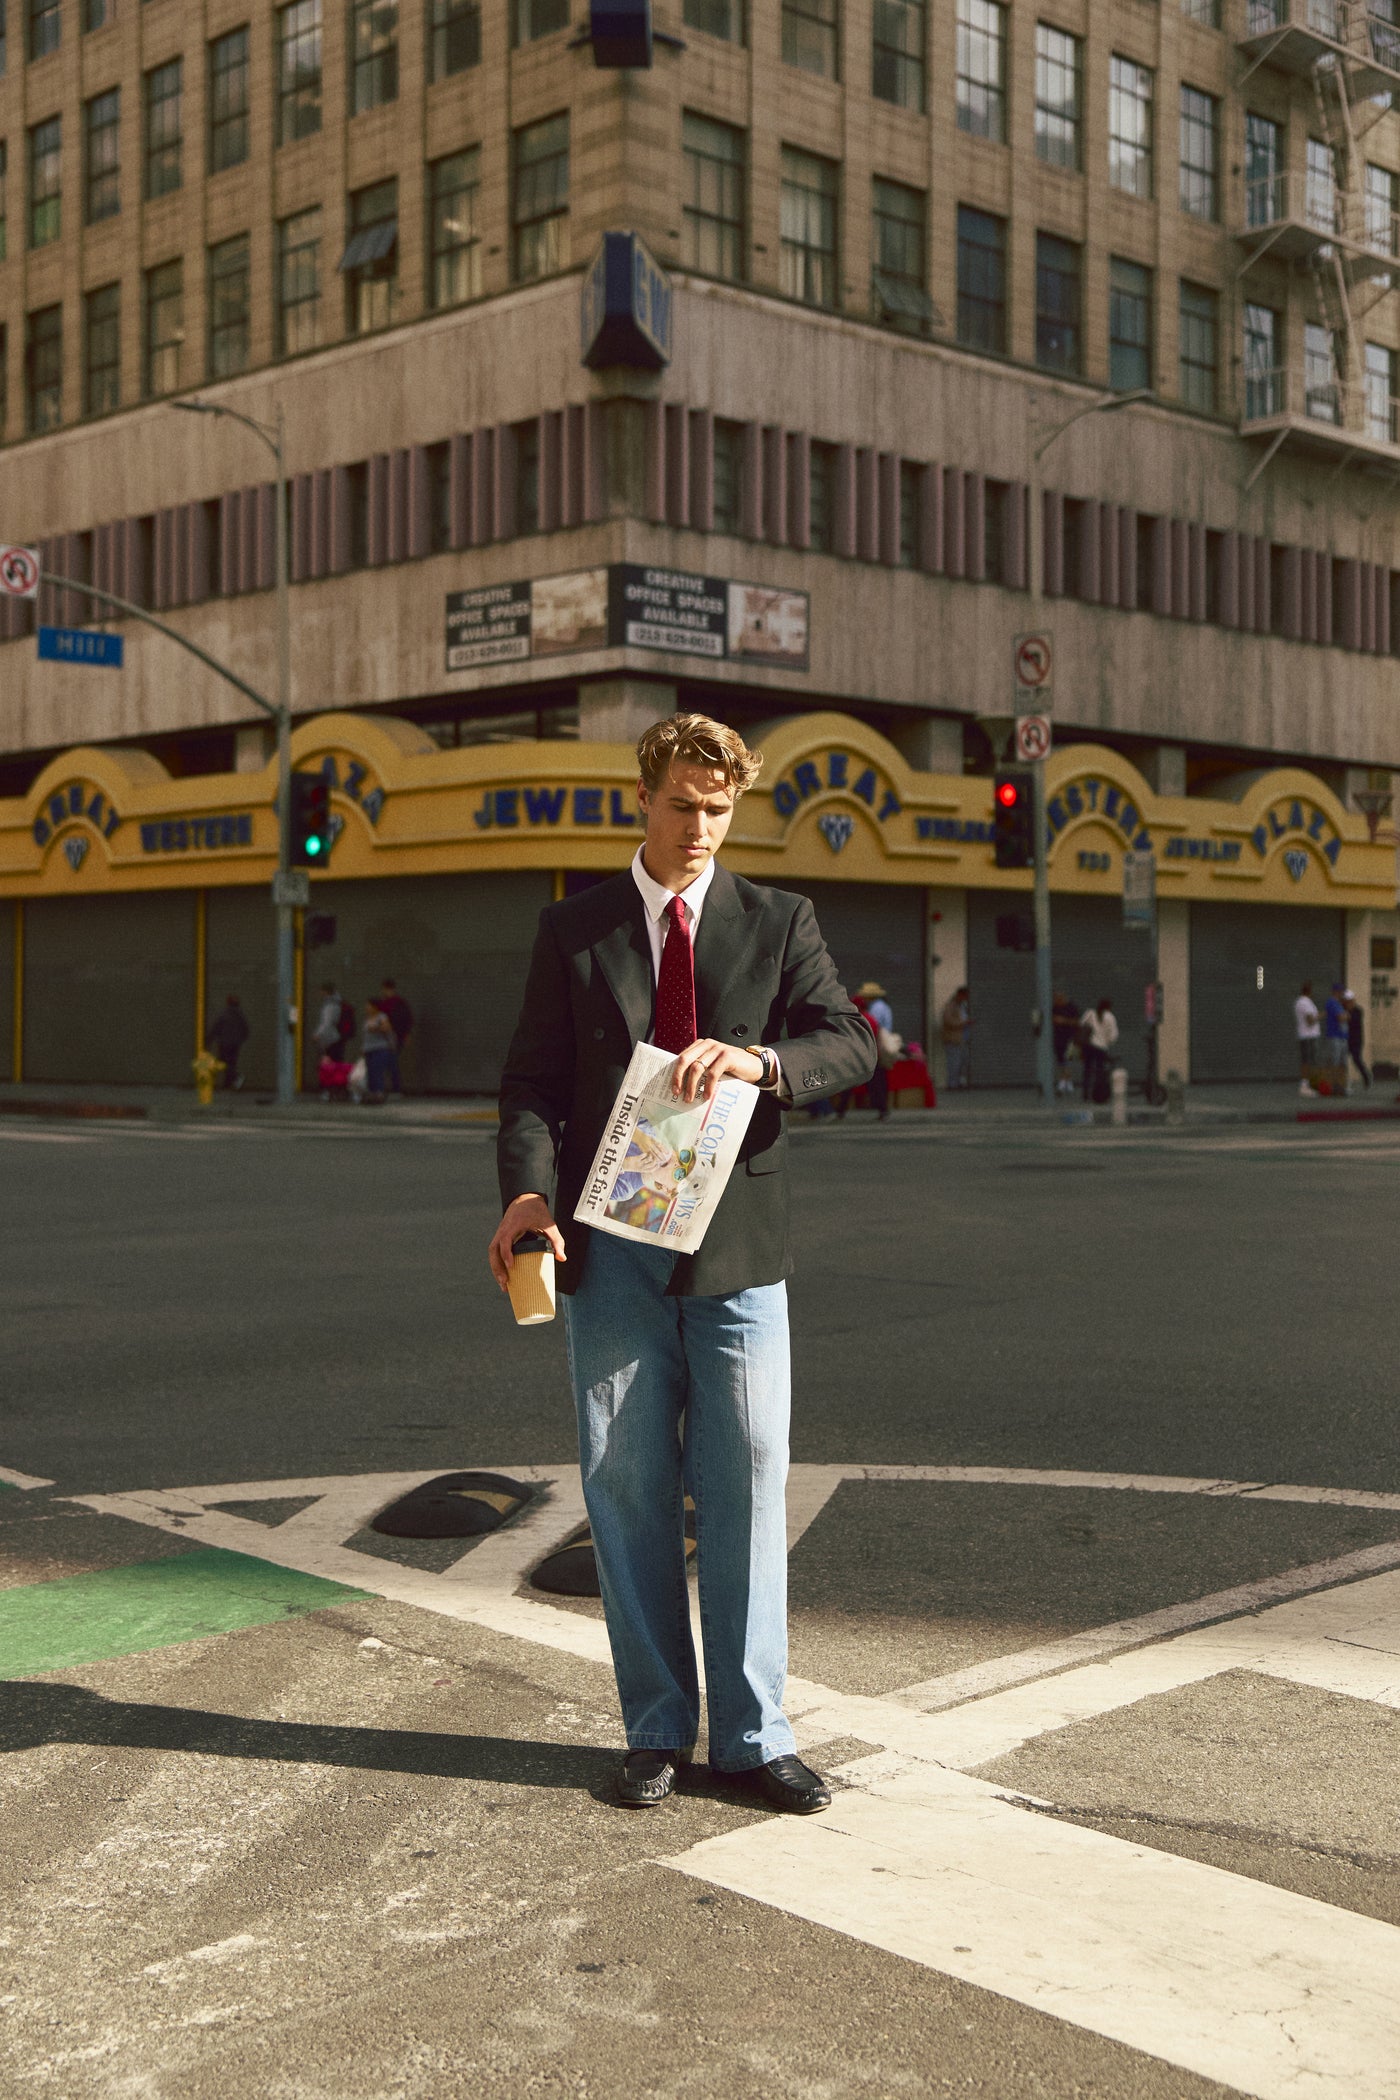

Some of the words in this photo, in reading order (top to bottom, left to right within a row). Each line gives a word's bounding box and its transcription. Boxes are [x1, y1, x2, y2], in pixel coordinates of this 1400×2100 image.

[625, 584, 670, 605] OFFICE
[677, 593, 724, 614] SPACES
[646, 570, 704, 592] CREATIVE
[460, 621, 517, 642] AVAILABLE
[643, 606, 709, 629] AVAILABLE
[272, 756, 385, 828] AZA
[773, 753, 901, 822] GREAT
[33, 785, 121, 846] GREAT
[474, 787, 637, 828] JEWEL
[1047, 780, 1153, 851] ESTERN
[140, 814, 252, 853] WESTERN
[1165, 838, 1241, 861] JEWELRY
[1252, 801, 1341, 866] PLAZA
[610, 1093, 639, 1145] Inside
[713, 1089, 740, 1123] THE
[698, 1123, 726, 1163] COA
[599, 1148, 617, 1175] the
[587, 1176, 607, 1210] fair
[675, 1199, 697, 1219] WS
